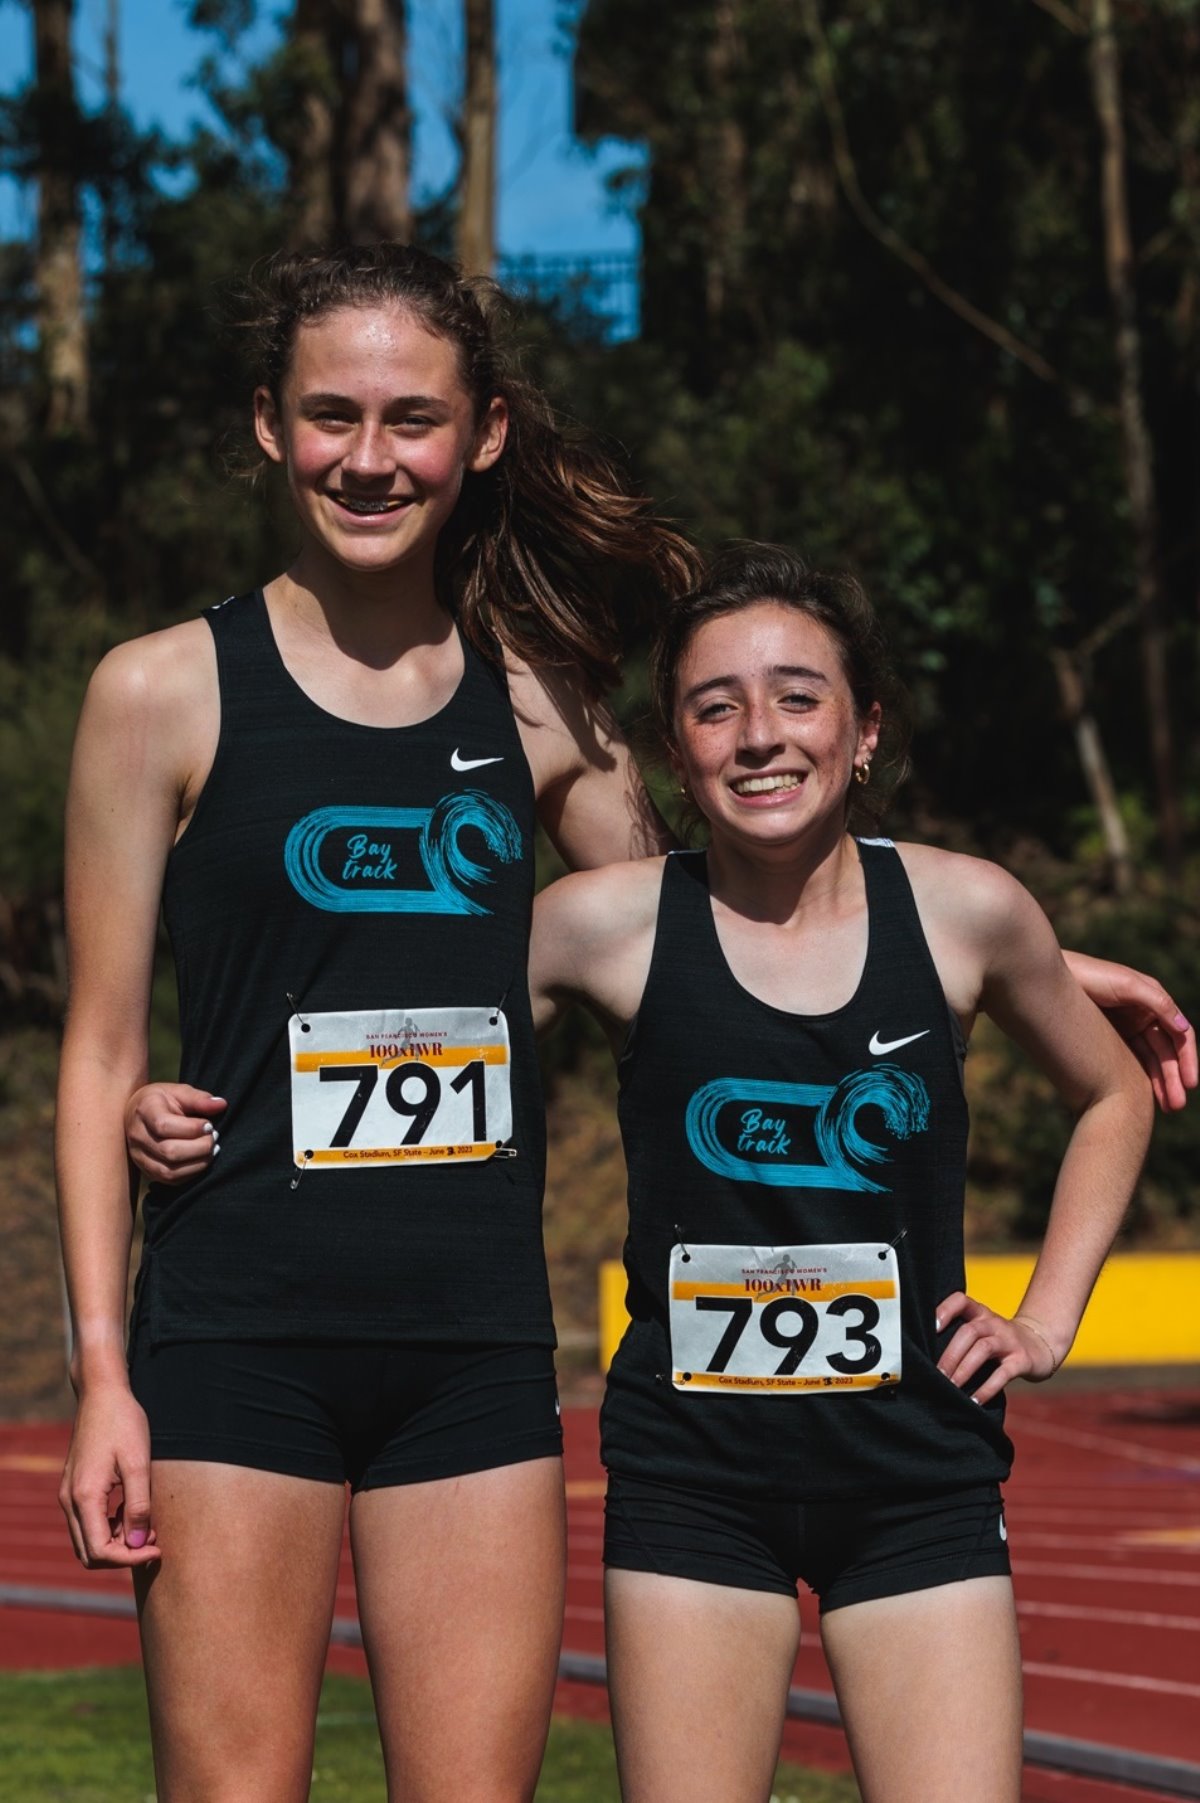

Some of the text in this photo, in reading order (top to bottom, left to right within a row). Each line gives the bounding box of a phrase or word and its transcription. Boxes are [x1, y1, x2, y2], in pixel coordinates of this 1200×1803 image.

[346, 833, 391, 864] Bay
[380, 1031, 418, 1039] FRANCSCO
[319, 1061, 487, 1148] 791
[741, 1108, 786, 1139] Bay
[393, 1149, 402, 1157] SF
[403, 1148, 422, 1156] State
[429, 1148, 444, 1156] June
[695, 1294, 882, 1375] 793
[777, 1378, 796, 1386] State
